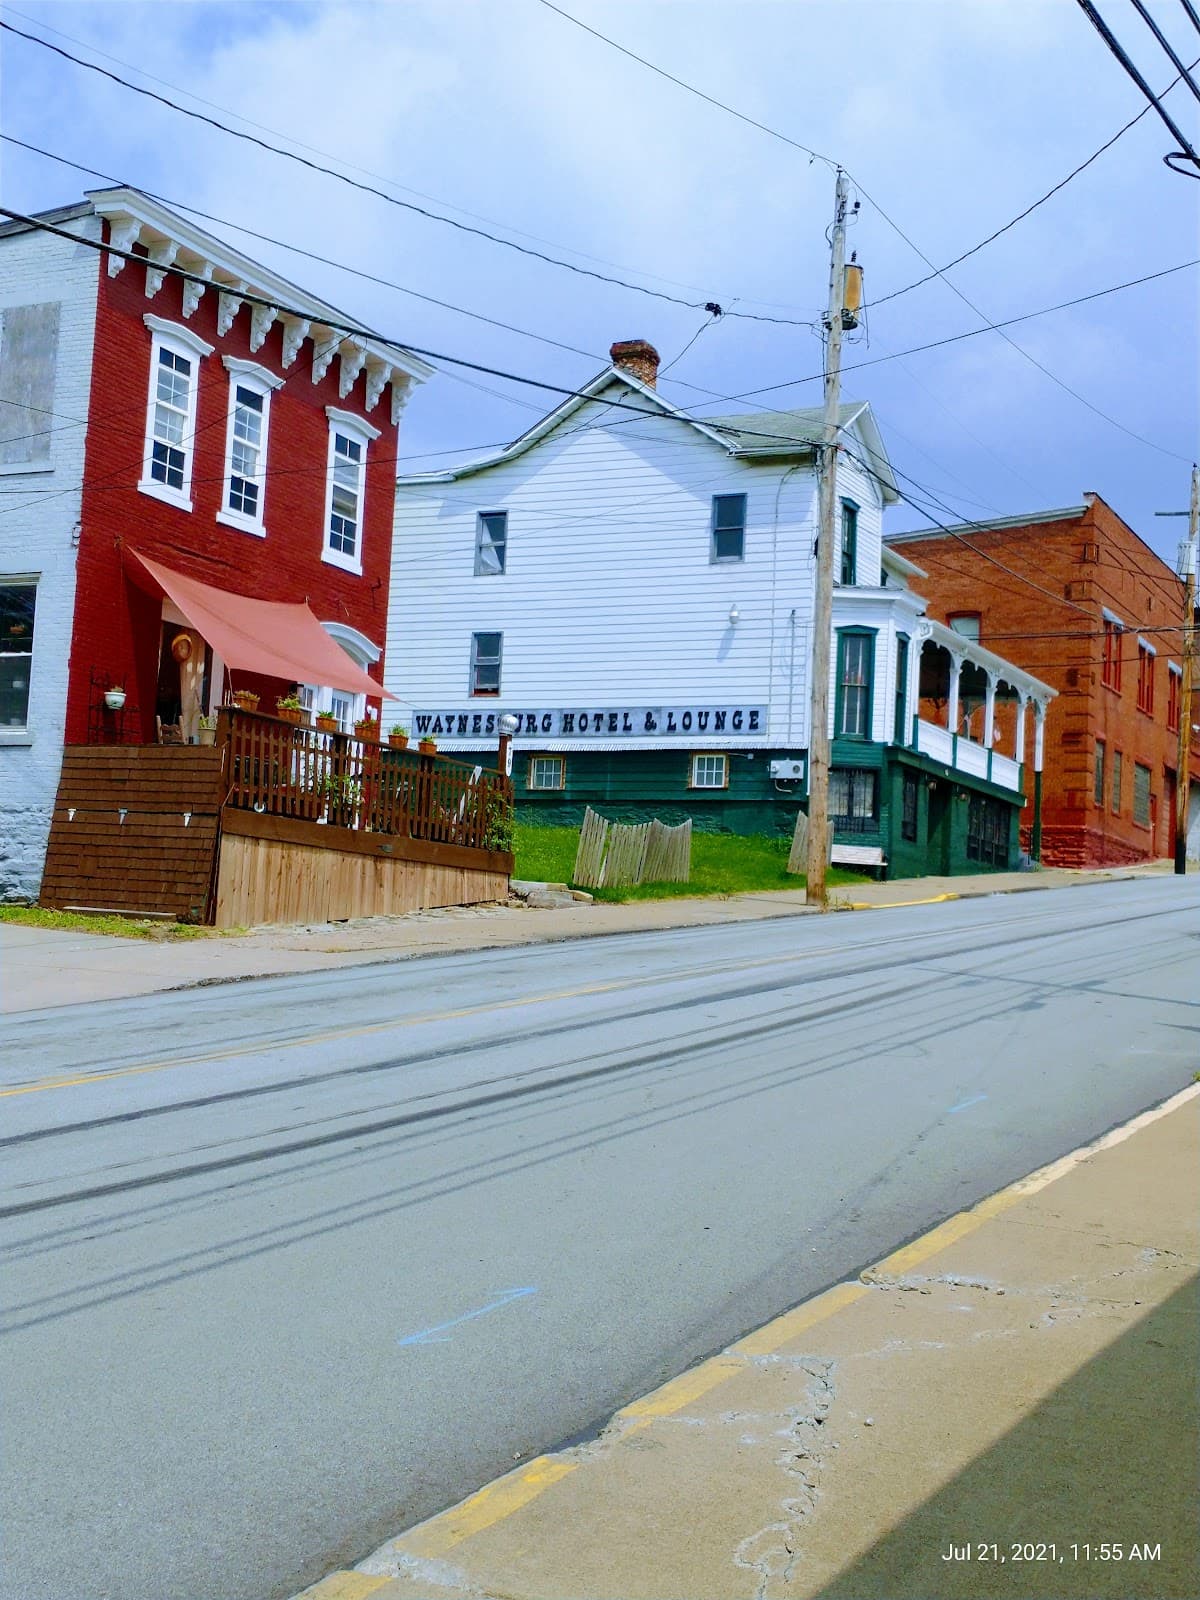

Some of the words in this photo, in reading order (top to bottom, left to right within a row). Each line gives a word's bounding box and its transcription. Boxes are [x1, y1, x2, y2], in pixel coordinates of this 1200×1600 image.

[416, 713, 552, 734] WAYNESURG
[563, 712, 632, 733] HOTEL
[644, 711, 657, 731] &
[667, 710, 759, 731] LOUNGE
